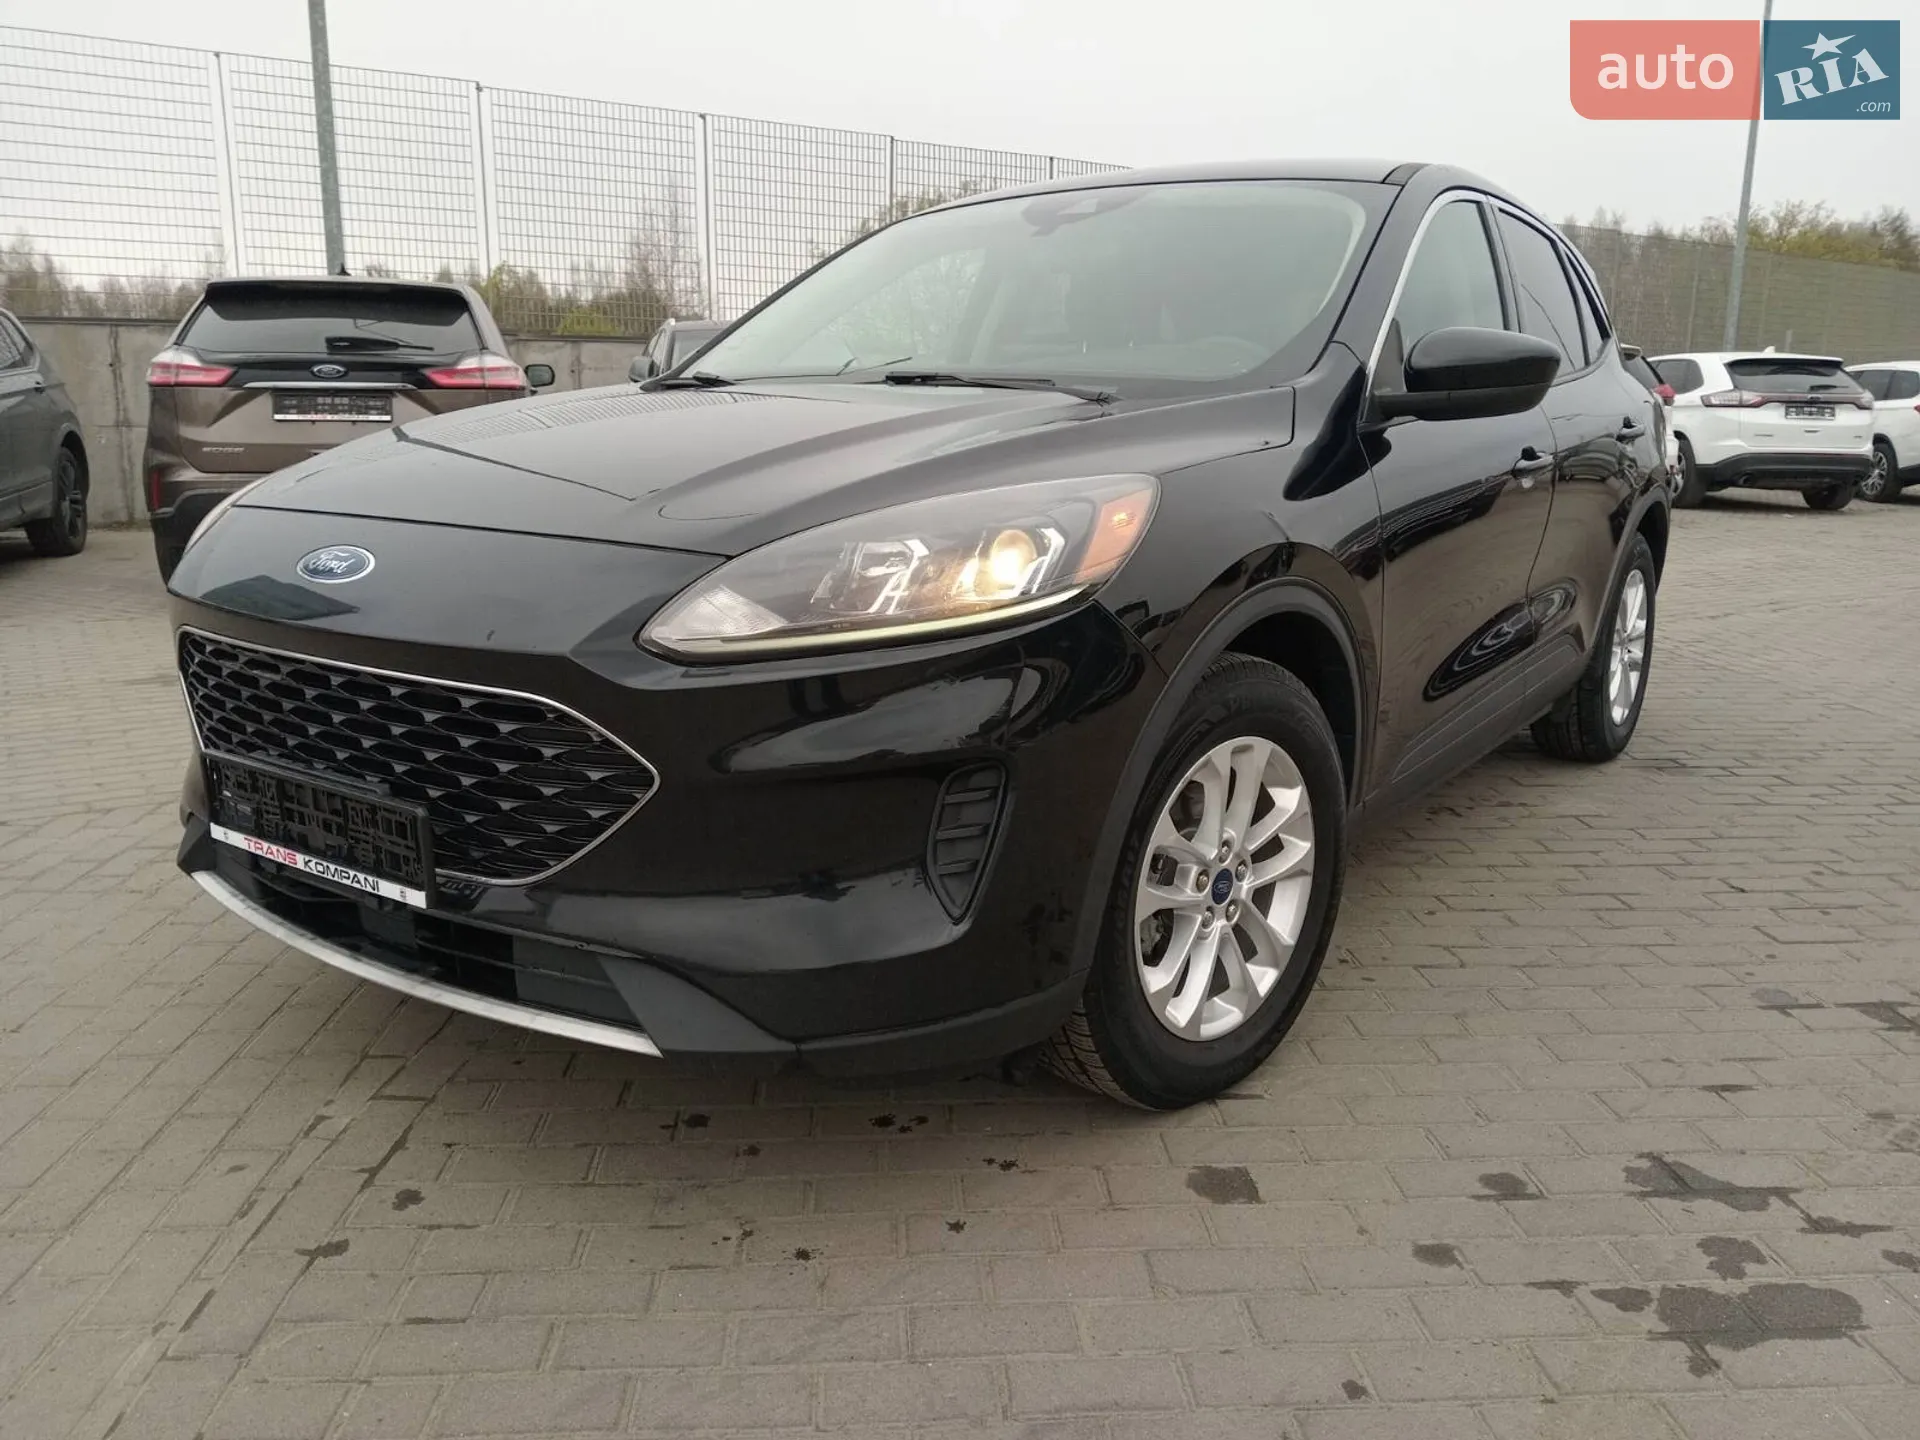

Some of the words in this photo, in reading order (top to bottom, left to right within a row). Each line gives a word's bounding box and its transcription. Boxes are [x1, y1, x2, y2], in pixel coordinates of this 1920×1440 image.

[308, 550, 356, 574] Ford
[243, 836, 298, 866] TRANS
[303, 856, 380, 893] KOMPANI
